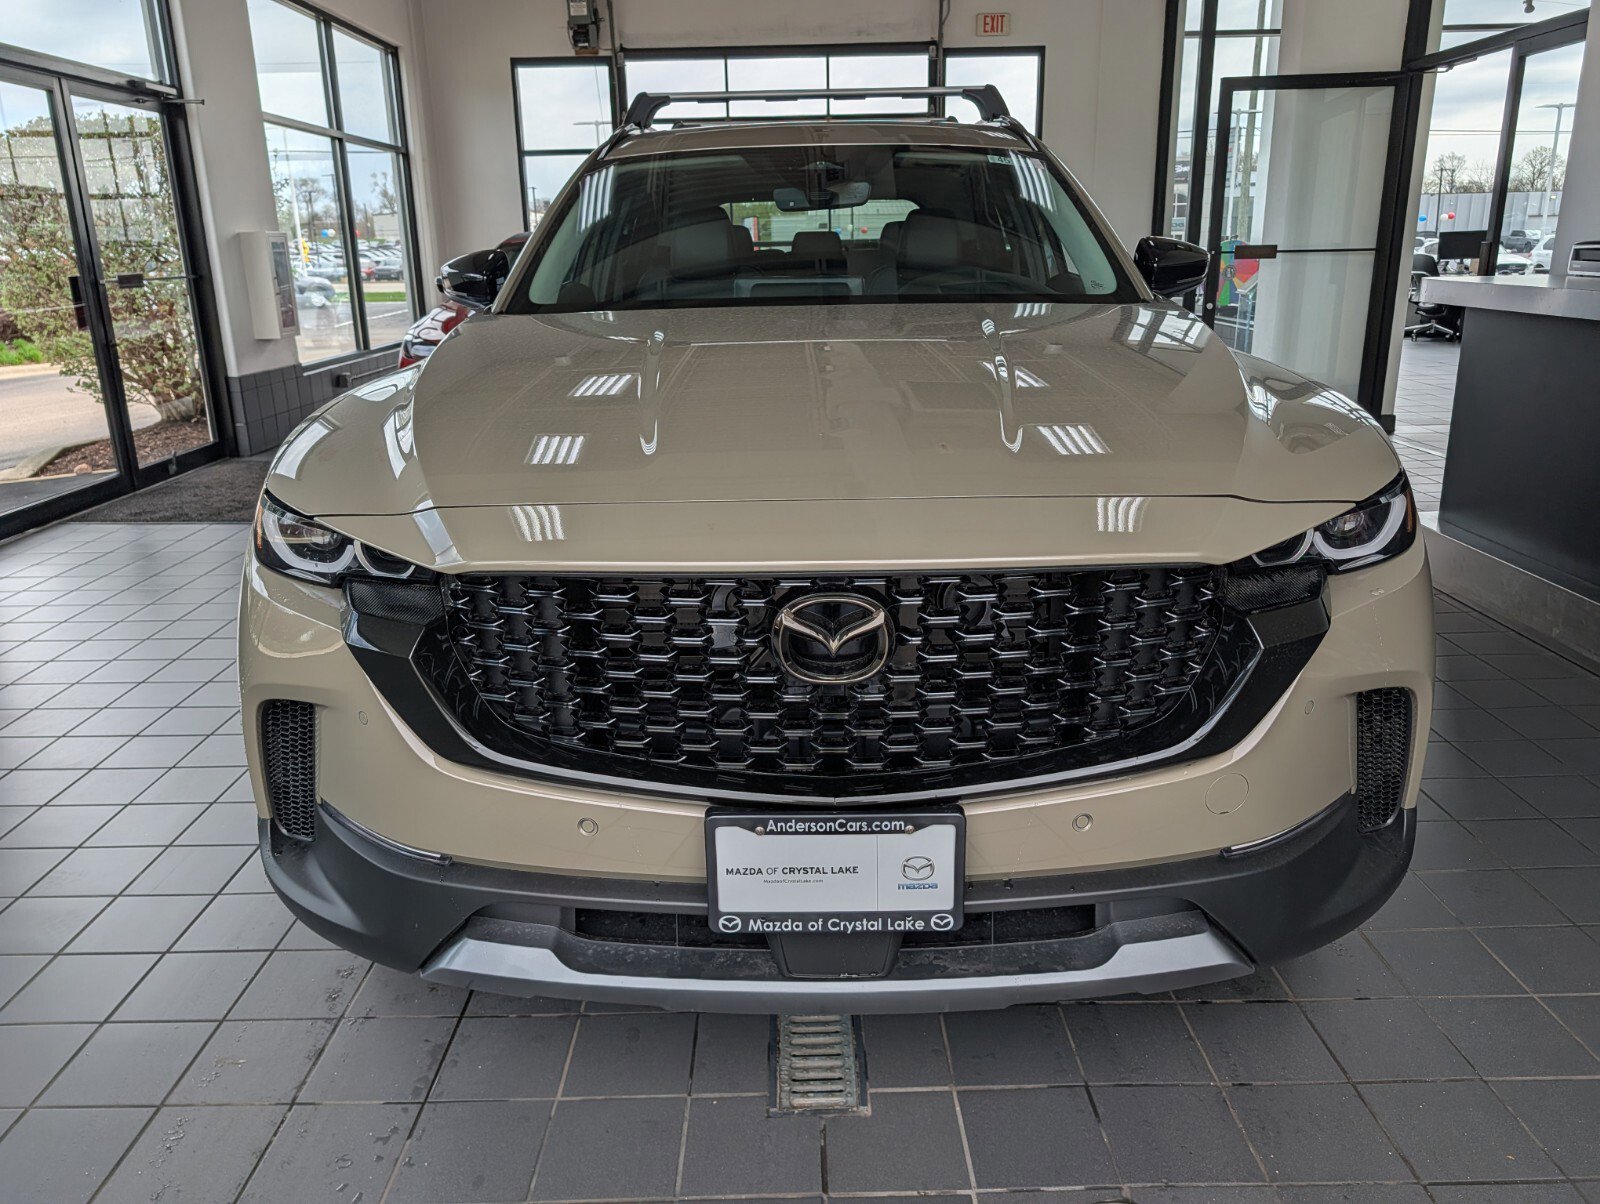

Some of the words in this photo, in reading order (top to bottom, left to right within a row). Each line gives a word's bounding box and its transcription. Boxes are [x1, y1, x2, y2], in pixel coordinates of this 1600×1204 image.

[983, 14, 1006, 33] EXIT
[766, 819, 905, 833] AndersonCars.com
[725, 866, 763, 876] MAZDA
[766, 866, 779, 876] OF
[781, 866, 828, 875] CRYSTAL
[830, 865, 859, 875] LAKE
[748, 918, 803, 932] Mazda
[808, 918, 823, 932] of
[827, 917, 883, 935] Crystal
[887, 916, 925, 931] Lake
